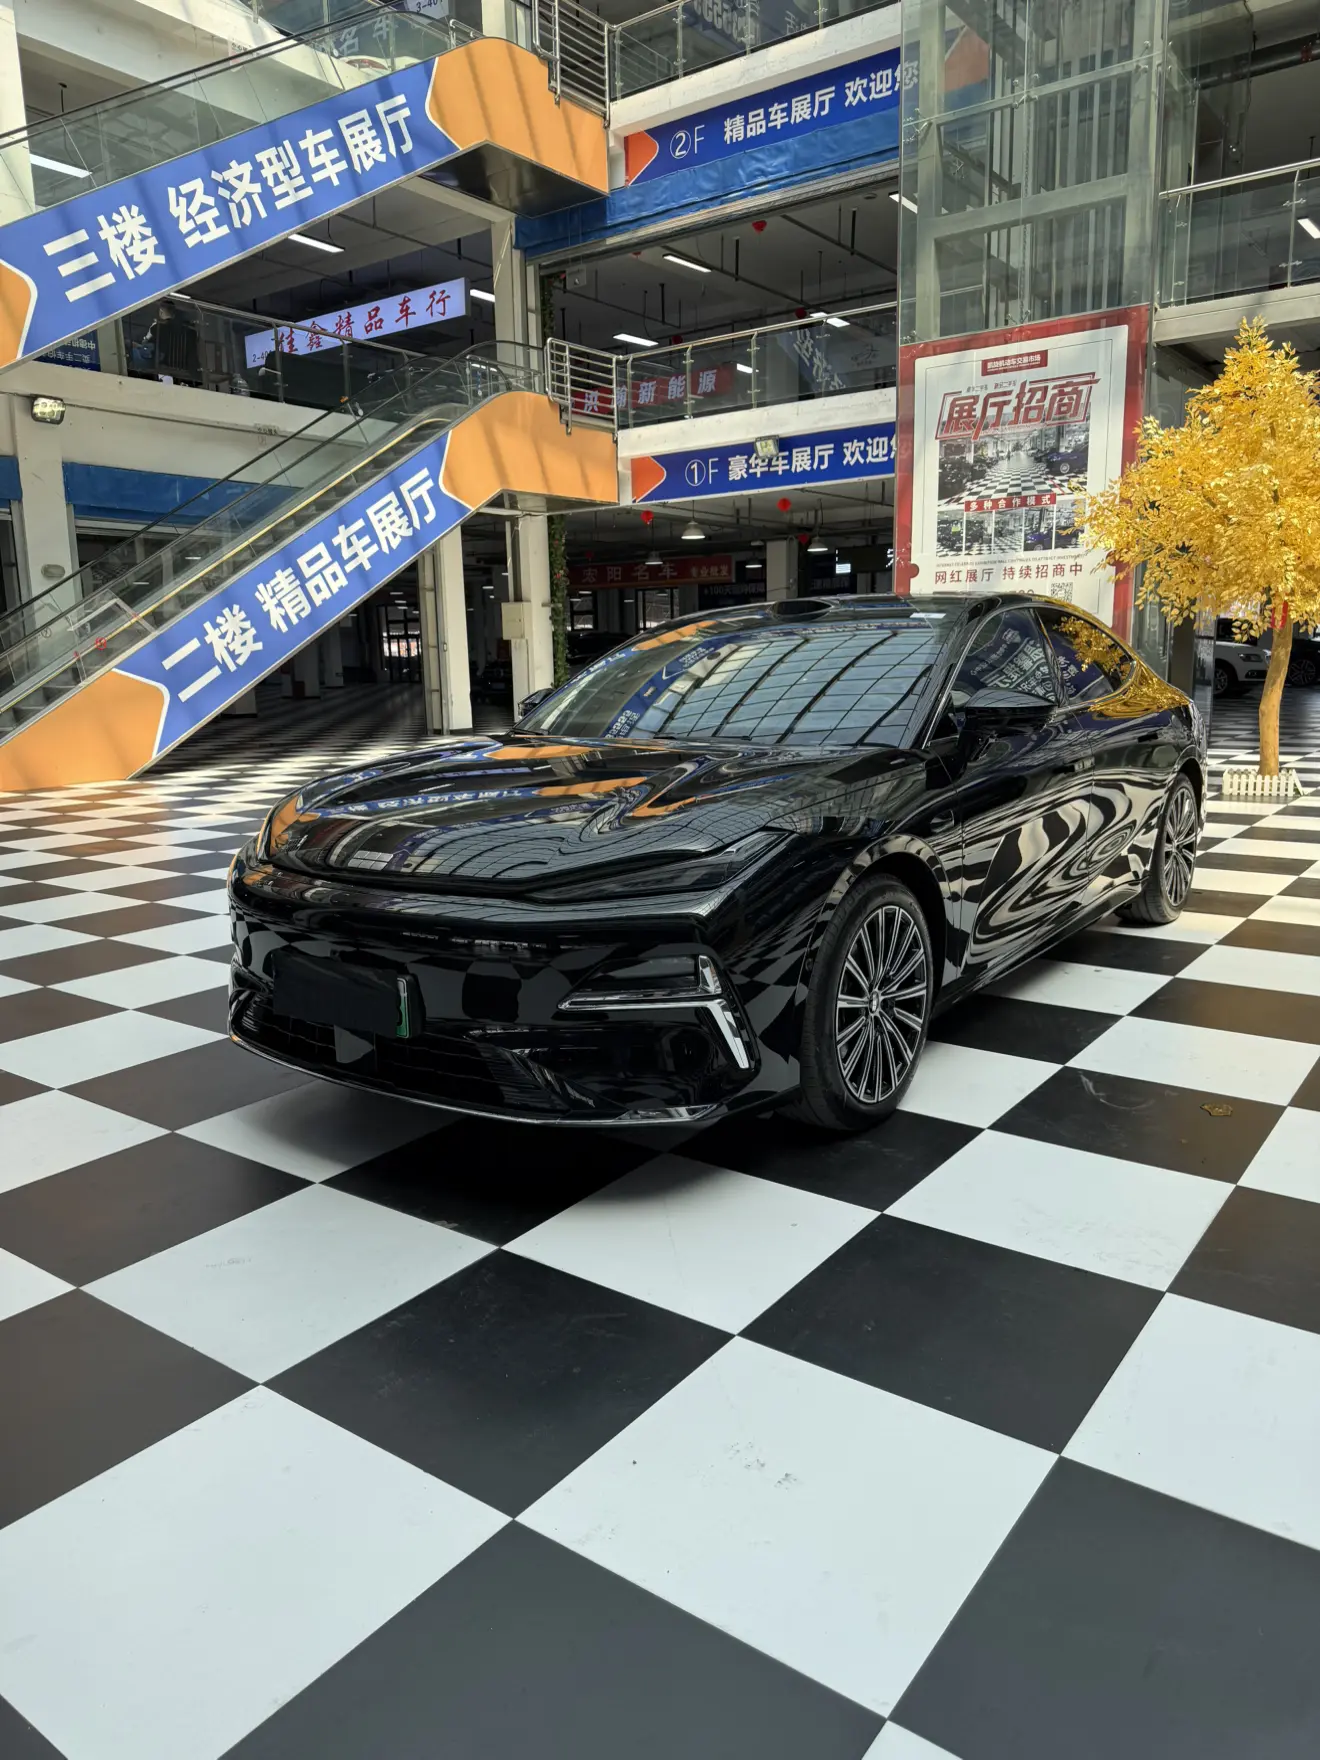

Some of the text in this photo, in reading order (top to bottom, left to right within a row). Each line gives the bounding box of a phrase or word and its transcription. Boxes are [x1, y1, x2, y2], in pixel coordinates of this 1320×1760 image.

[723, 86, 836, 145] 精品车展厅
[43, 93, 413, 302] 三楼 经济型车展厅
[943, 378, 1102, 441] 展厅招商
[969, 494, 1051, 512] 多种合作模式
[161, 468, 437, 703] 二楼 精品车展厅
[935, 561, 1084, 585] 网红展厅 持续招商中
